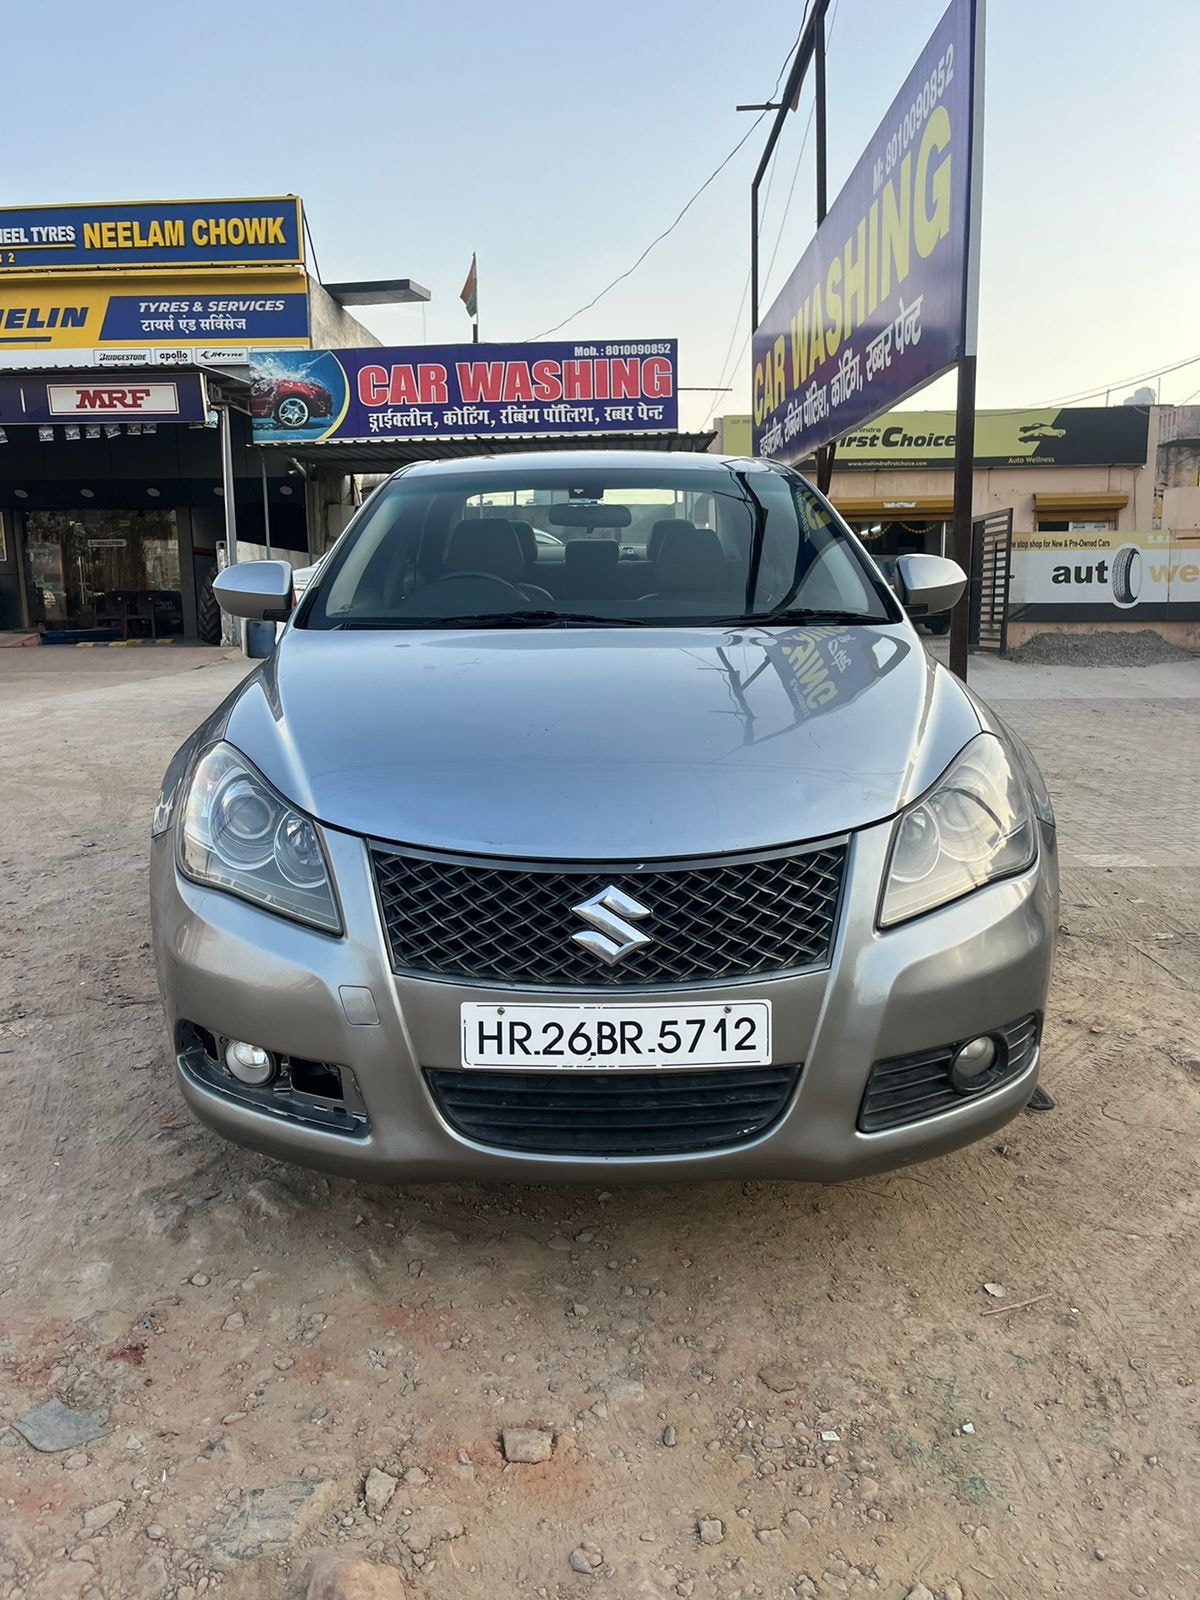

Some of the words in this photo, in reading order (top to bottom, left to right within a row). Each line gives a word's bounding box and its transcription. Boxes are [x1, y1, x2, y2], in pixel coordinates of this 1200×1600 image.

[885, 43, 954, 175] 8010090852
[30, 225, 76, 243] TYRES
[83, 219, 185, 249] NEELAM
[192, 217, 286, 247] CHOWK
[753, 334, 786, 427] CAR
[790, 105, 952, 391] WASHING
[139, 301, 190, 313] TYRES
[192, 301, 203, 312] &
[207, 300, 285, 312] SERVICES
[0, 307, 89, 329] ELIN
[141, 314, 175, 332] टायर्स
[178, 315, 196, 333] एंड
[199, 313, 246, 331] सर्विसेज
[160, 351, 188, 361] apollo
[357, 364, 449, 407] CAR
[455, 356, 673, 403] WASHING
[75, 389, 151, 409] MRF
[443, 406, 496, 427] कोटिंग,
[543, 403, 600, 425] पॉलिश,
[604, 405, 634, 422] रब्बर
[637, 402, 664, 420] पेन्ट
[839, 433, 880, 448] irst
[881, 426, 956, 448] Choice
[1008, 456, 1024, 464] Auto
[1026, 456, 1055, 464] Wellness
[1017, 540, 1028, 550] stop
[1029, 539, 1042, 550] shop
[1043, 539, 1051, 548] for
[1052, 539, 1063, 548] New
[1069, 539, 1097, 548] Pre-Owned
[1098, 538, 1110, 548] Cars
